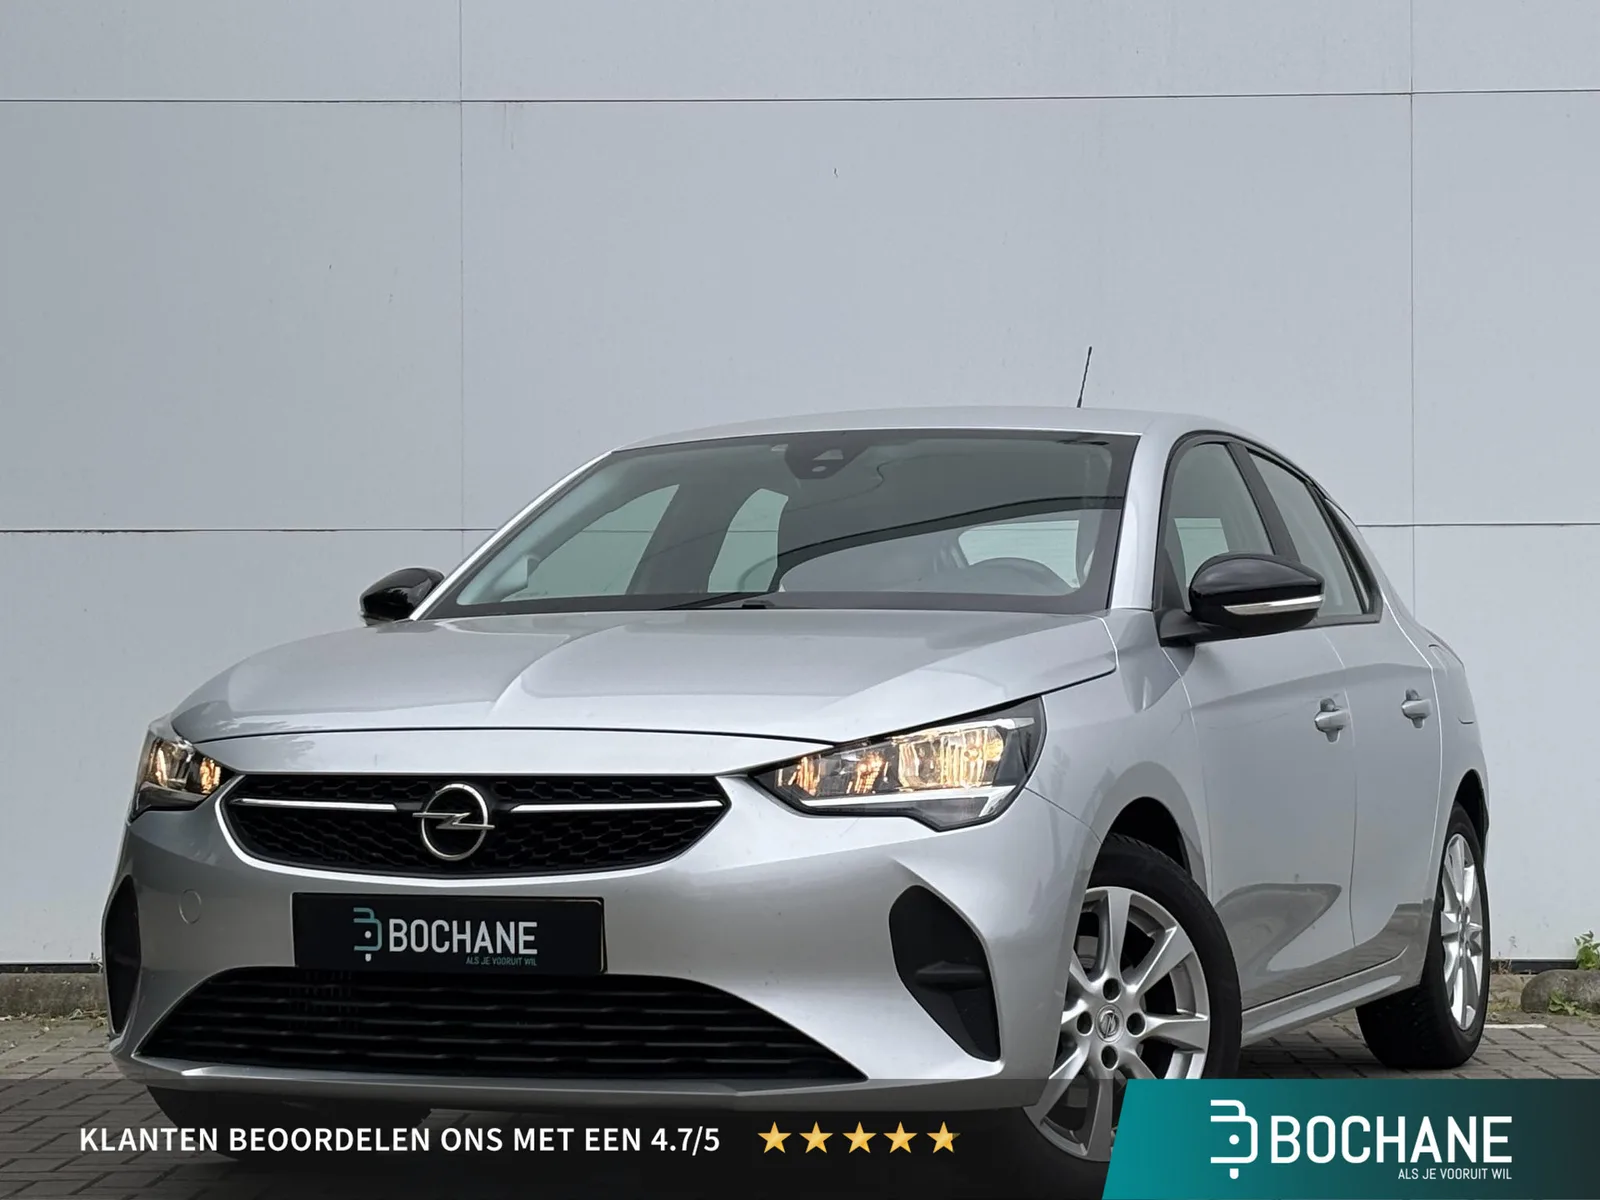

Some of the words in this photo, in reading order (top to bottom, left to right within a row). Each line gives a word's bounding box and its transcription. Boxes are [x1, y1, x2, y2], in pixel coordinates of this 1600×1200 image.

[389, 918, 538, 955] BOCHANE
[466, 956, 480, 965] ALS
[481, 956, 491, 965] JE
[492, 956, 522, 966] VOORUIT
[524, 957, 538, 966] WIL
